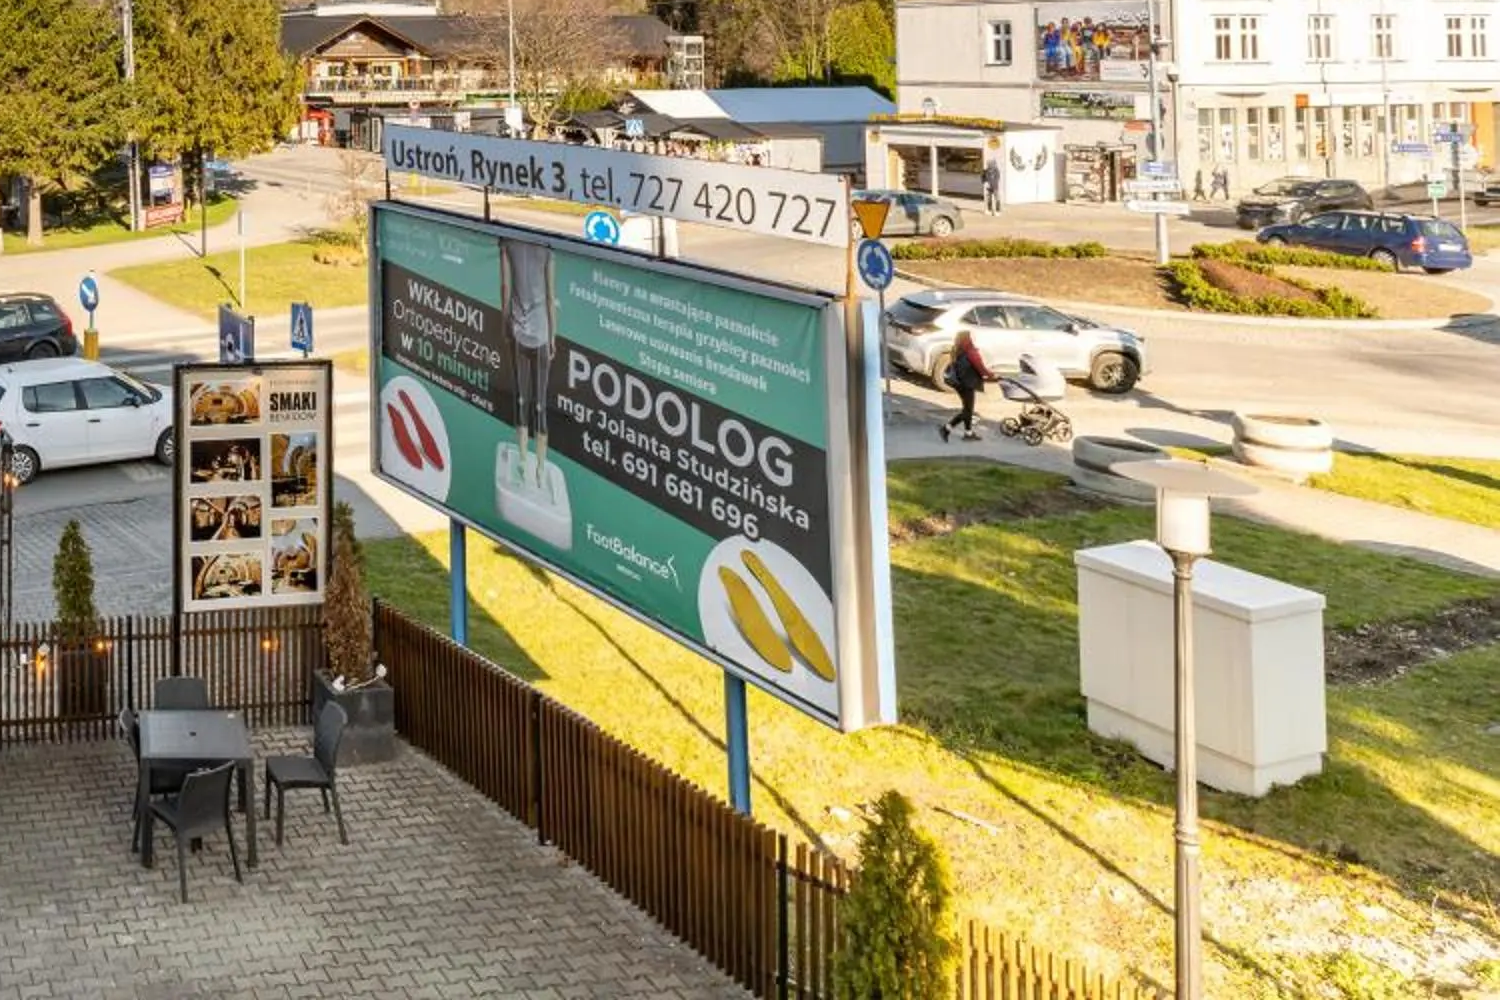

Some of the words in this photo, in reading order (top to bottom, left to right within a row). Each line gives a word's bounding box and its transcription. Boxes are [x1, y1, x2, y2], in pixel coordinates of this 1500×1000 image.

[391, 139, 465, 182] Ustroń,
[471, 149, 545, 190] Rynek
[551, 161, 573, 199] 3,
[580, 167, 621, 204] tel.
[630, 172, 683, 213] 727
[694, 182, 756, 225] 420
[768, 191, 837, 237] 727
[393, 299, 500, 369] Ortopedyczne
[407, 279, 484, 333] WKŁADKI
[401, 332, 413, 351] w
[417, 339, 434, 361] 10
[437, 350, 489, 391] minut!
[269, 391, 317, 412] SMAKI
[568, 349, 794, 487] PODOLOG
[557, 393, 594, 422] mgr
[598, 409, 672, 463] Jolanta
[677, 449, 810, 531] Studzińska
[582, 431, 617, 466] tel.
[622, 451, 659, 487] 691
[665, 474, 704, 512] 681
[710, 498, 760, 538] 696
[586, 523, 669, 579] FootBalance
